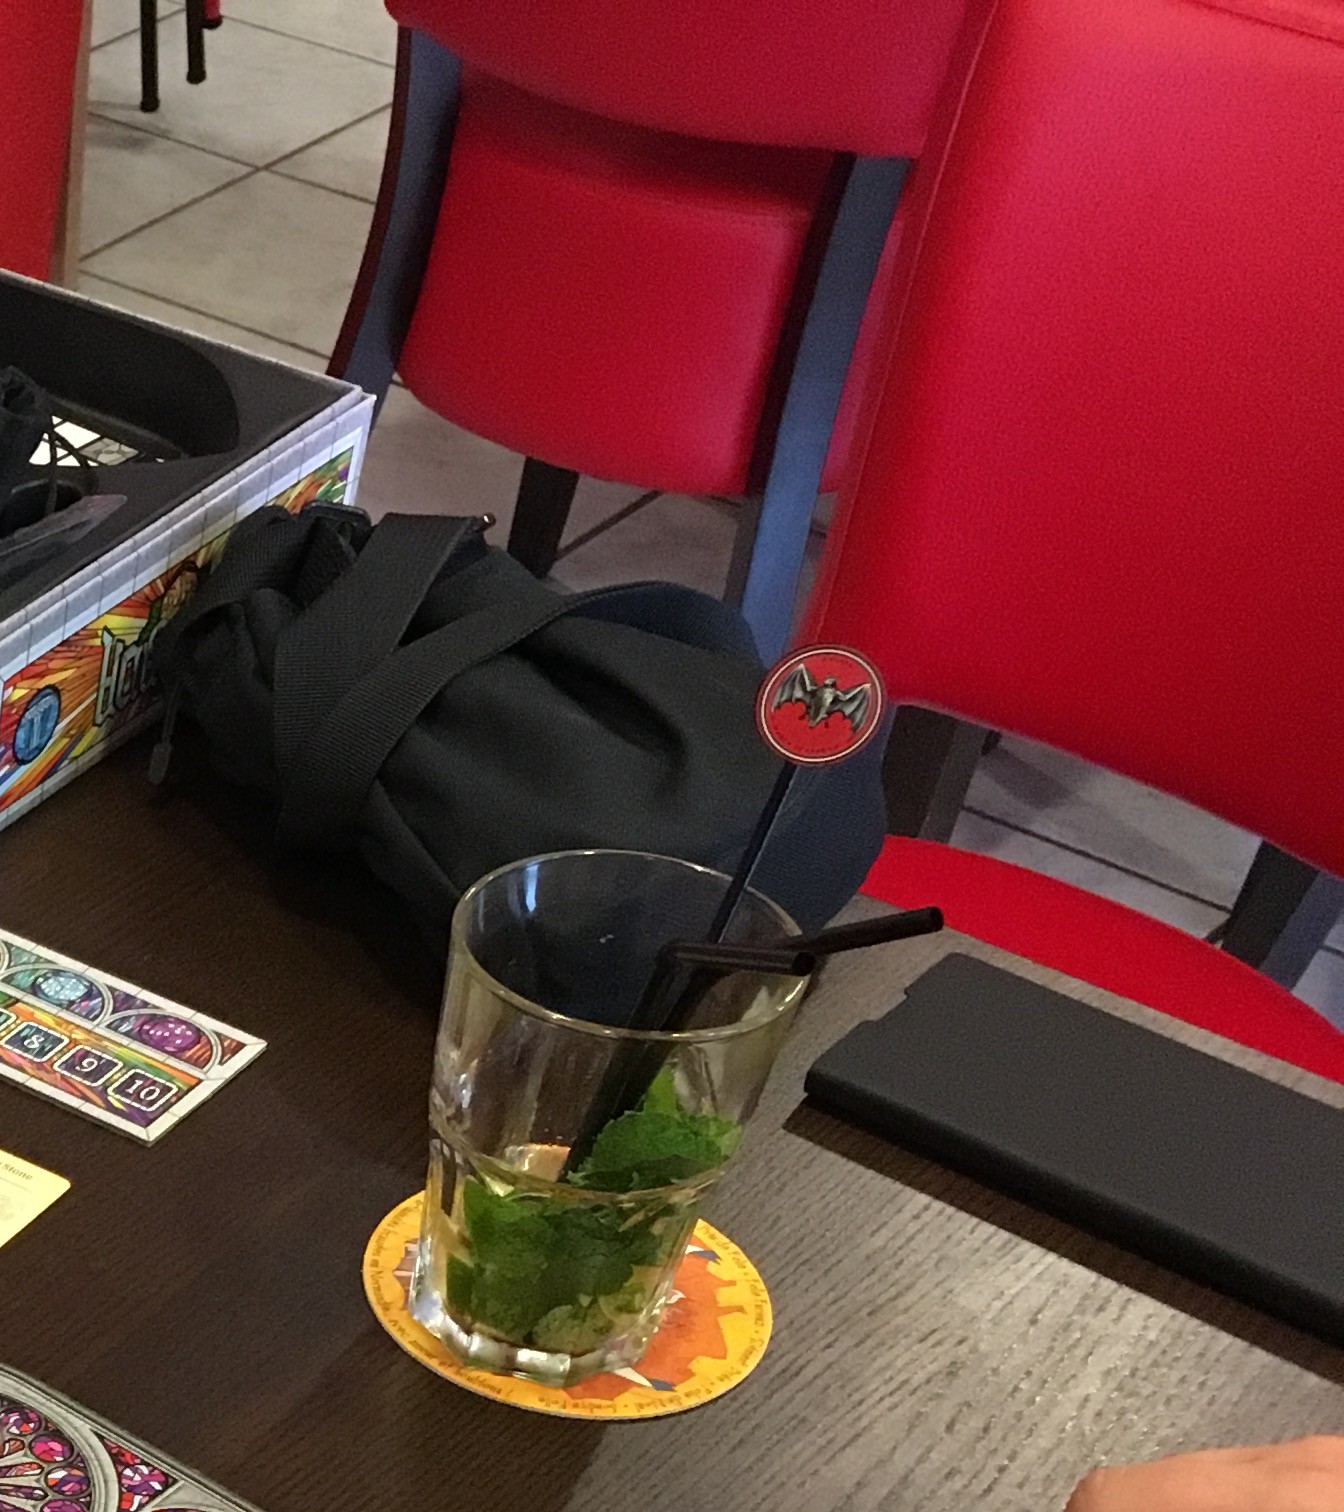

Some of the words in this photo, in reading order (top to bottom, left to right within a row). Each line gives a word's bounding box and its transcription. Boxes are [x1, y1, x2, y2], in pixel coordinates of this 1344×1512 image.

[23, 1034, 45, 1049] 8
[75, 1057, 99, 1072] 9
[125, 1079, 161, 1101] 10
[2, 1164, 34, 1180] Stone
